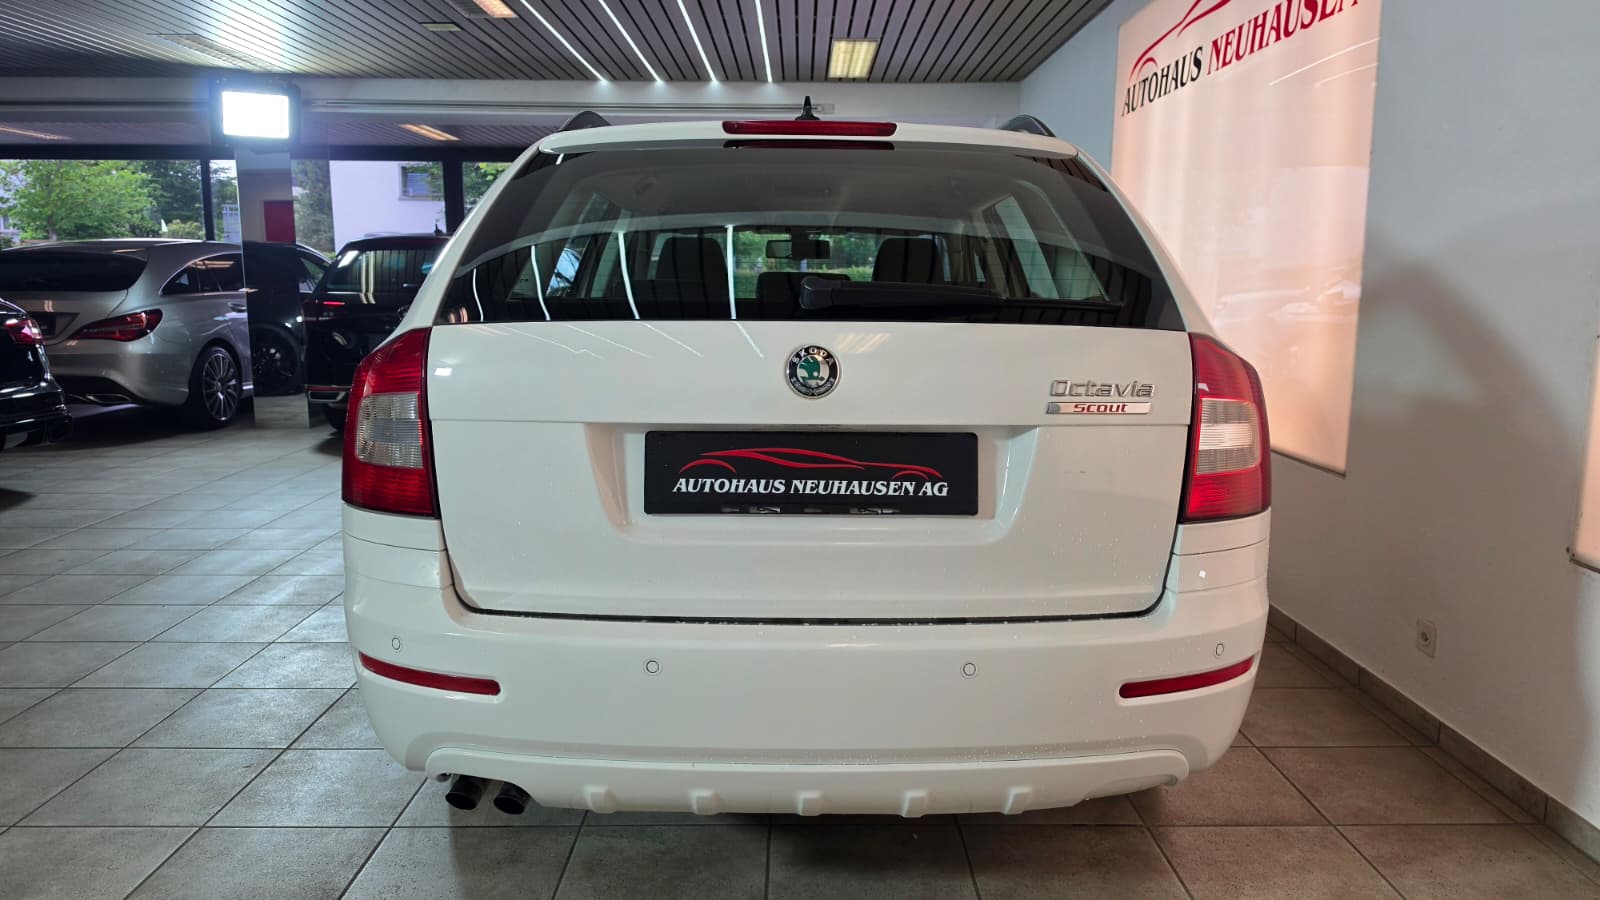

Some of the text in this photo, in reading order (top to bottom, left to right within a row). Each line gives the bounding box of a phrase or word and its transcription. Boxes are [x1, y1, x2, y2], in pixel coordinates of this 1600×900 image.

[1122, 0, 1358, 117] AUTOHAUS NEUHAUS
[1049, 380, 1156, 398] Octavia
[672, 478, 949, 497] AUTOHAUS NEUHAUSEN AG
